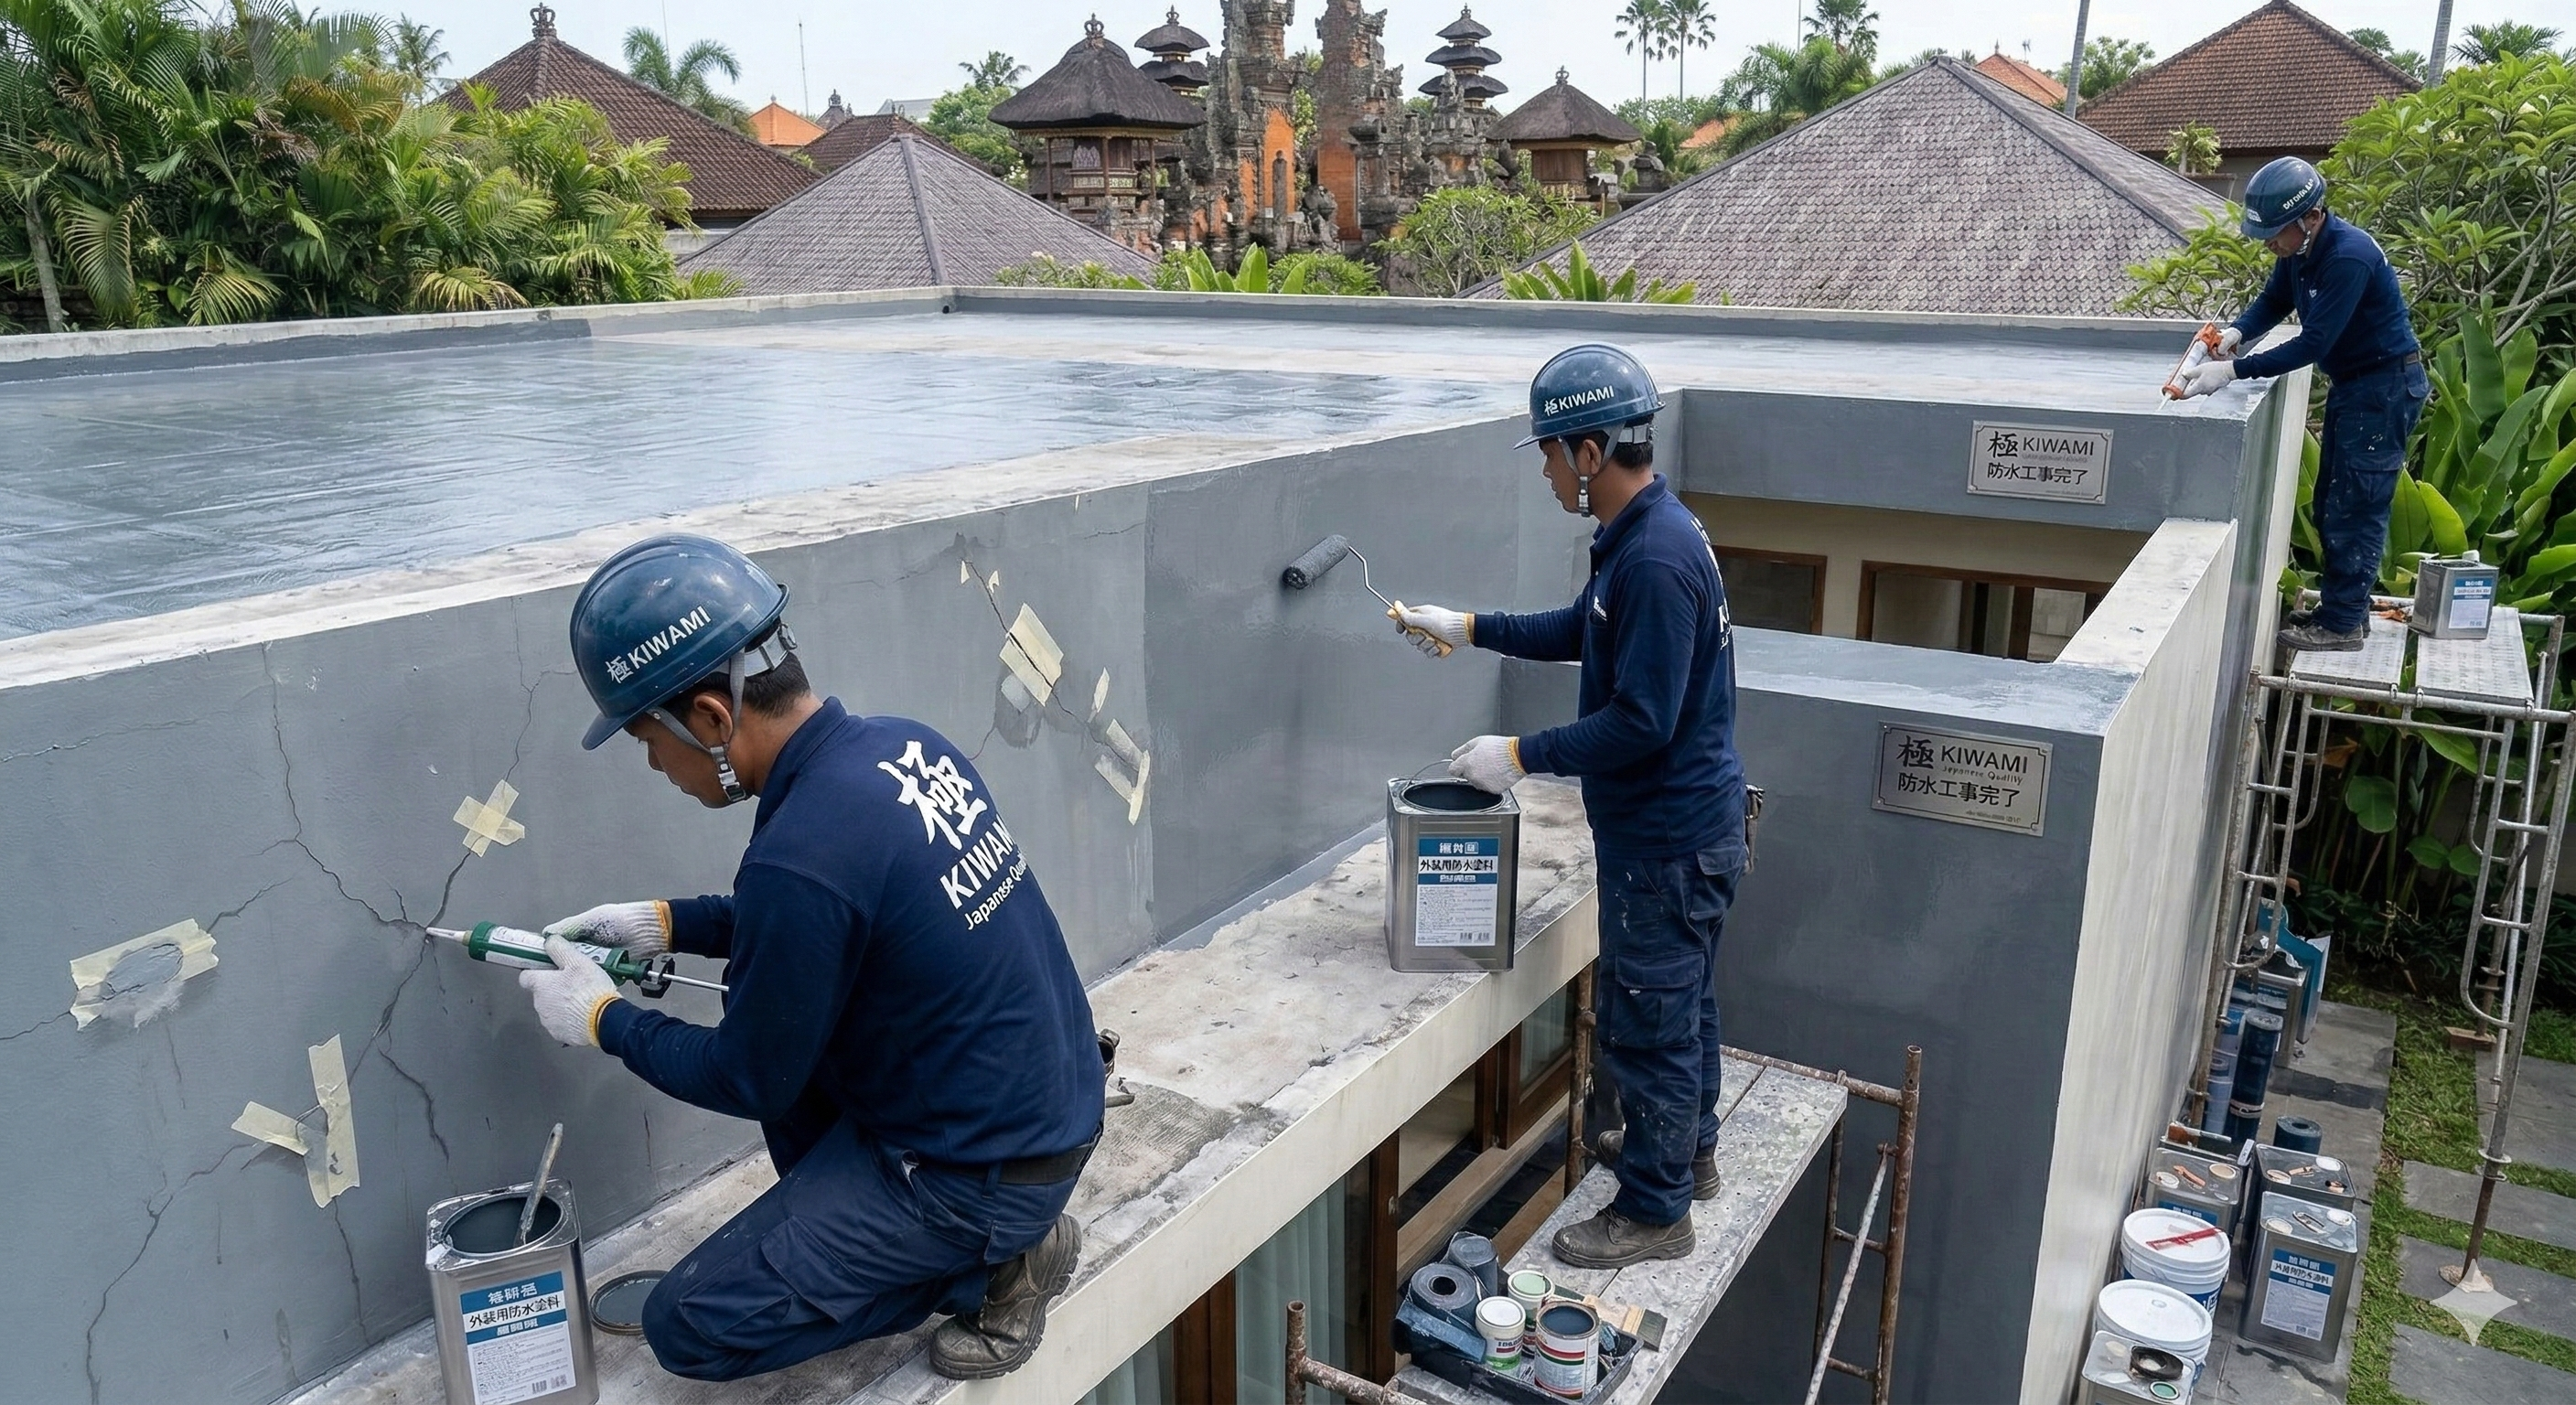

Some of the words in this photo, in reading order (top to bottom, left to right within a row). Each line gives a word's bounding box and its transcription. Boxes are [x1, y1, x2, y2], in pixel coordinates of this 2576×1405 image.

[1559, 385, 1615, 411] KIWAMI
[1987, 431, 2018, 458] 極
[2023, 437, 2094, 456] KIWAMI
[1988, 462, 2088, 485] 防水工事完了
[606, 655, 633, 683] 極
[628, 606, 712, 670] KIWAMI
[1896, 735, 1935, 769] 極
[1941, 745, 2028, 774] KIWAMI
[877, 741, 988, 851] 極
[1898, 772, 2020, 808] 防水工事完了
[939, 813, 1016, 909] KIWAM
[965, 877, 1014, 930] Japanese
